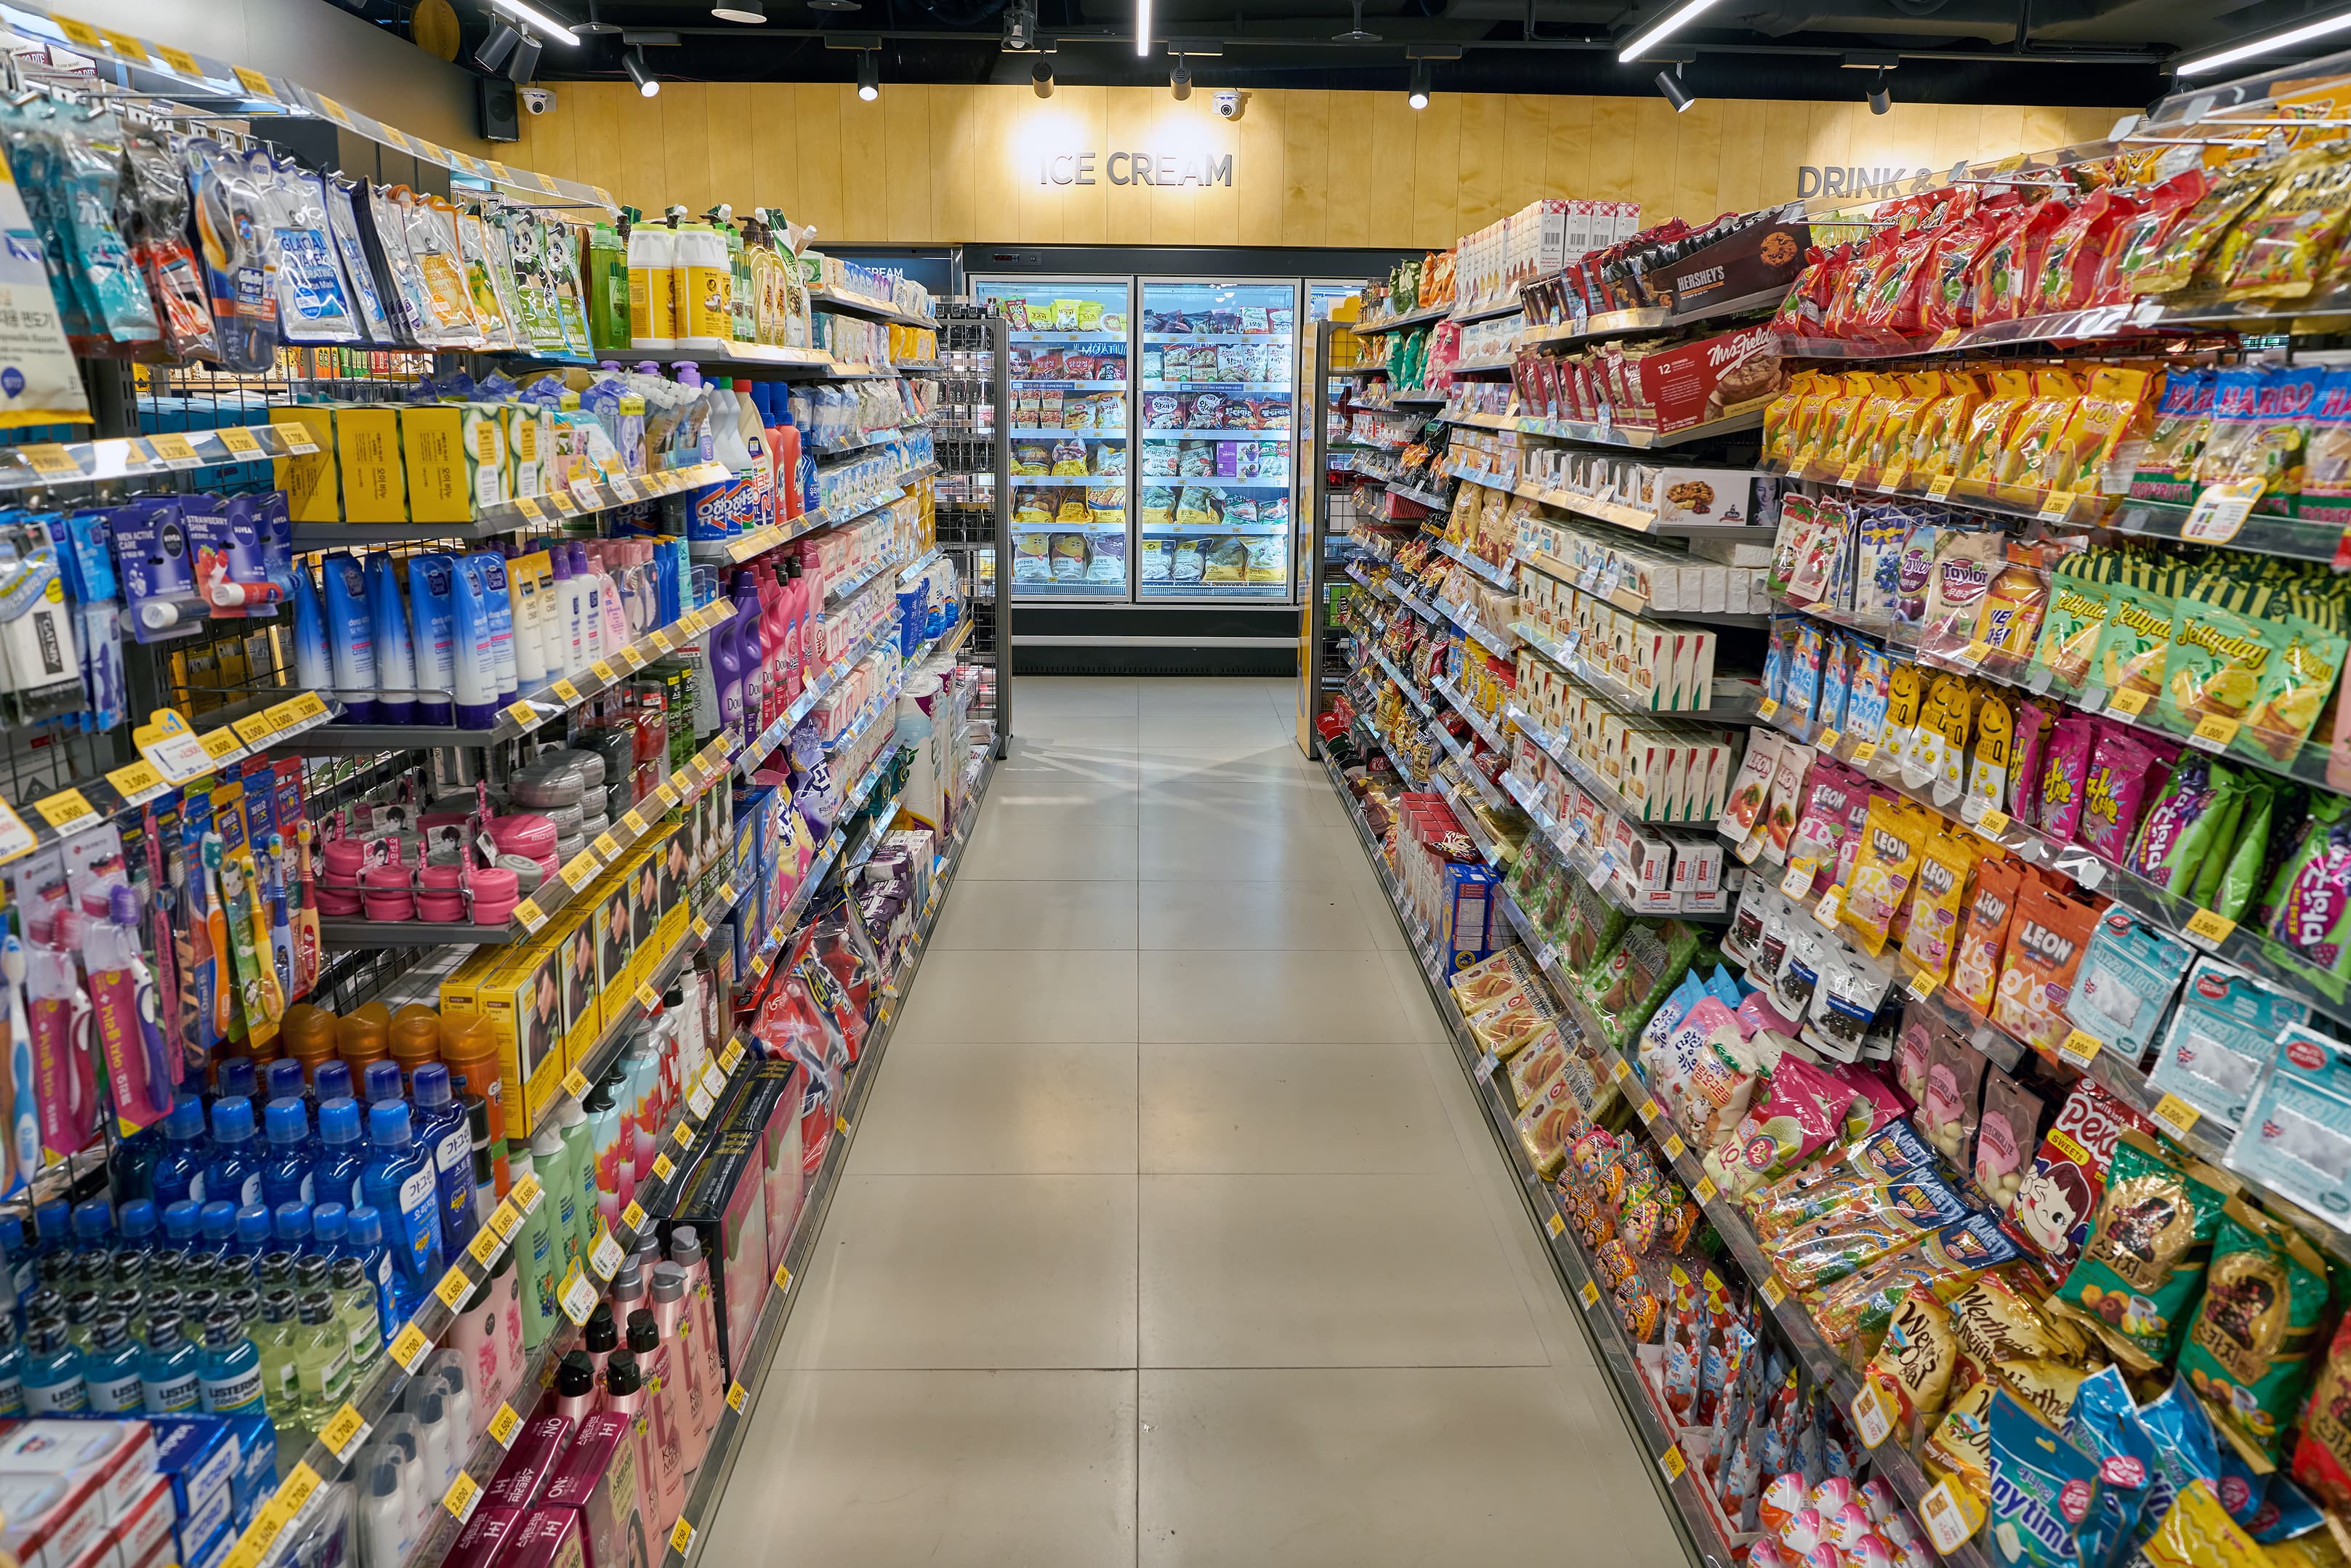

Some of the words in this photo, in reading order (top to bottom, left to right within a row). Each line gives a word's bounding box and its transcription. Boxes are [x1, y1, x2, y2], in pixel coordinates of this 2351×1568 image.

[1041, 152, 1095, 185] ICE
[1107, 152, 1232, 187] CREAM
[1796, 166, 1906, 199] DRINK
[1909, 166, 1934, 196] &
[281, 235, 326, 251] GLACIAL
[1677, 265, 1725, 291] HERSHEY'S
[1658, 363, 1671, 375] 12
[2219, 381, 2315, 415] HARIBO
[186, 514, 228, 527] STRAWBERRY
[188, 523, 209, 533] SHINE
[233, 525, 253, 534] NIVEA
[273, 516, 286, 525] NIVEA
[117, 533, 132, 542] MEN
[132, 530, 155, 541] ACTIVE
[118, 540, 137, 551] CARE
[164, 534, 182, 543] NIVEA
[1903, 553, 1932, 575] Taylor
[1942, 562, 1988, 586] Taylor
[2177, 616, 2271, 670] Jellyday
[302, 703, 323, 716] 3,000
[1898, 703, 1908, 724] Q
[2118, 700, 2133, 711] 700
[273, 714, 294, 727] 3,000
[243, 724, 265, 740] 3,000
[1953, 725, 1964, 747] Q
[2203, 725, 2225, 740] 1,000
[209, 740, 231, 756] 1,800
[1993, 740, 2003, 762] Q
[124, 773, 150, 790] 3,000
[1812, 783, 1847, 811] LEON
[1983, 816, 1999, 830] 2,000
[1874, 828, 1909, 860] LEON
[1921, 857, 1955, 895] LEON
[1975, 887, 2007, 926] LEON
[2019, 919, 2075, 969] LEON
[1914, 979, 1927, 993] 2,500
[1675, 1030, 1703, 1055] 말랑
[2068, 1039, 2088, 1054] 3,000
[2161, 1105, 2184, 1124] 2,000
[446, 1131, 470, 1155] 가그린
[2049, 1132, 2084, 1163] SWEETS
[410, 1168, 434, 1196] 가그린
[480, 1240, 493, 1258] 4,500
[447, 1281, 464, 1301] 4,500
[1704, 1278, 1718, 1287] NEW
[401, 1338, 420, 1361] 1,700
[209, 1373, 260, 1398] LISTERINE
[214, 1392, 241, 1406] COOL
[332, 1420, 354, 1444] 1,700
[499, 1417, 512, 1436] 4,500
[599, 1423, 618, 1436] 1+1
[491, 1478, 510, 1495] 1+1
[451, 1487, 469, 1511] 2,800
[483, 1521, 506, 1538] 1+1
[541, 1520, 562, 1538] 1+1
[676, 1528, 687, 1548] 6,750
